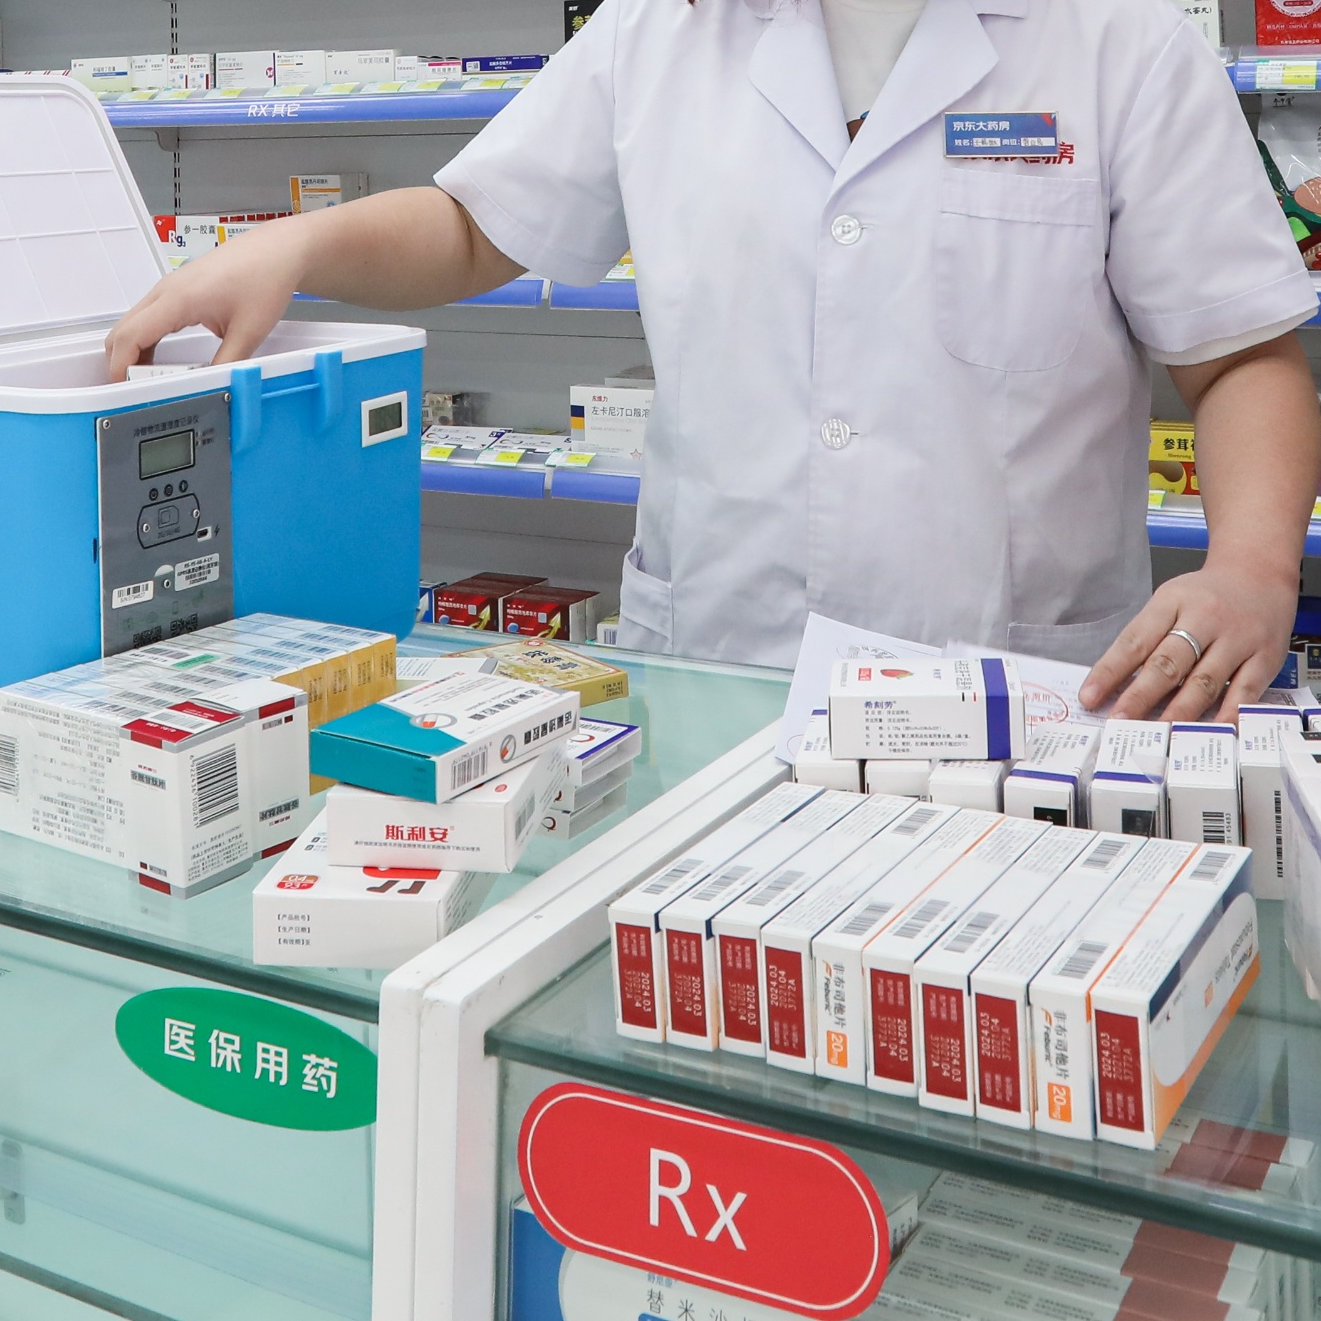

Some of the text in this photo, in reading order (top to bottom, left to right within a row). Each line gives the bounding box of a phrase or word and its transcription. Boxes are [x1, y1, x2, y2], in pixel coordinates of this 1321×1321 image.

[247, 103, 301, 117] RX 其它
[952, 121, 1011, 132] 京东大药房
[183, 223, 217, 237] 参一胶囊
[384, 823, 449, 844] 斯利安
[162, 1015, 340, 1100] 医保用药
[1050, 1084, 1068, 1121] 20mg
[646, 1146, 749, 1253] Rx
